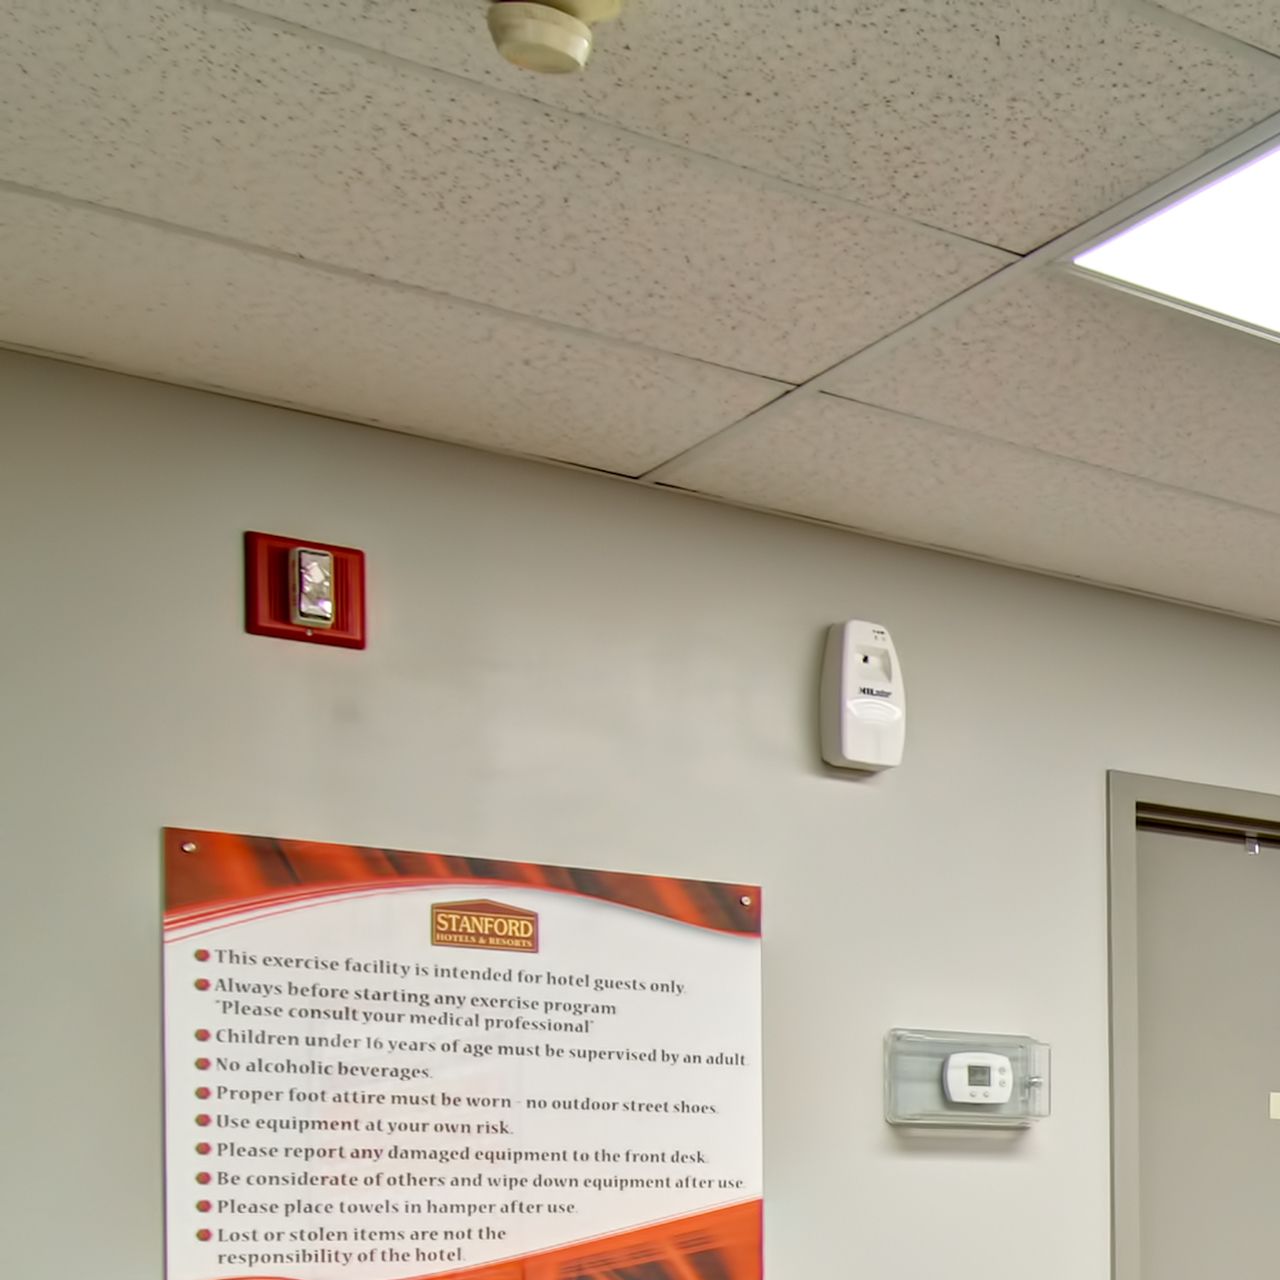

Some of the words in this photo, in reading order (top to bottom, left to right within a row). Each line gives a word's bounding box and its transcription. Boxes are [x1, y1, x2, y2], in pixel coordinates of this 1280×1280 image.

[436, 913, 534, 938] STANFORD
[436, 933, 476, 944] HOTELS
[488, 936, 533, 947] RESORTS
[213, 948, 259, 967] This
[261, 954, 341, 972] exercise
[343, 956, 412, 980] facility
[414, 962, 430, 978] is
[433, 963, 514, 984] intended
[516, 969, 544, 985] for
[545, 970, 591, 989] hotel
[592, 977, 648, 993] guests
[214, 976, 284, 999] Always
[286, 980, 351, 1001] before
[352, 987, 432, 1008] starting
[433, 993, 468, 1010] any
[469, 995, 541, 1012] exercise
[542, 1000, 617, 1017] program
[286, 1005, 360, 1023] consult
[360, 1009, 407, 1026] your
[408, 1010, 481, 1029] medical
[214, 1027, 301, 1047] Children
[303, 1032, 363, 1050] under
[365, 1035, 385, 1051] 16
[387, 1038, 437, 1055] years
[439, 1038, 462, 1054] of
[461, 1042, 495, 1059] age
[496, 1043, 541, 1058] must
[544, 1042, 566, 1059] be
[567, 1047, 658, 1064] supervised
[660, 1047, 681, 1067] by
[681, 1052, 703, 1065] an
[215, 1056, 242, 1073] No
[244, 1056, 334, 1077] alcoholic
[336, 1060, 434, 1082] beverages.
[215, 1084, 285, 1106] Proper
[287, 1086, 327, 1104] foot
[331, 1089, 387, 1106] attire
[389, 1092, 438, 1107] must
[440, 1091, 463, 1108] be
[464, 1095, 513, 1109] worn
[525, 1098, 549, 1110] no
[550, 1096, 621, 1112] outdoor
[621, 1099, 670, 1114] street
[672, 1099, 720, 1115] shoes.
[215, 1113, 252, 1130] Use
[254, 1115, 361, 1135] equipment
[363, 1118, 385, 1133] at
[386, 1120, 431, 1136] your
[432, 1121, 473, 1135] own
[475, 1119, 517, 1136] risk.
[216, 1141, 280, 1159] Please
[283, 1144, 347, 1163] report
[348, 1147, 385, 1164] any
[386, 1143, 471, 1165] damaged
[473, 1146, 569, 1166] equipment
[571, 1149, 591, 1163] to
[593, 1147, 622, 1164] the
[624, 1148, 667, 1164] front
[216, 1170, 242, 1187] Be
[244, 1170, 360, 1188] considerate
[362, 1170, 385, 1188] of
[385, 1171, 447, 1188] others
[448, 1171, 484, 1188] and
[486, 1173, 530, 1192] wipe
[531, 1172, 580, 1189] down
[582, 1174, 672, 1193] equipment
[674, 1174, 716, 1190] after
[216, 1197, 281, 1215] Please
[283, 1198, 335, 1219] place
[338, 1198, 400, 1215] towels
[403, 1199, 423, 1215] in
[426, 1198, 498, 1218] hamper
[498, 1198, 545, 1215] after
[217, 1227, 260, 1244] Lost
[262, 1230, 287, 1243] or
[288, 1225, 349, 1243] stolen
[352, 1226, 406, 1243] items
[408, 1229, 440, 1242] are
[442, 1227, 473, 1242] not
[476, 1225, 508, 1241] the
[217, 1247, 354, 1269] responsibility
[356, 1247, 378, 1264] of
[379, 1246, 412, 1263] the
[414, 1246, 466, 1263] hotel.
